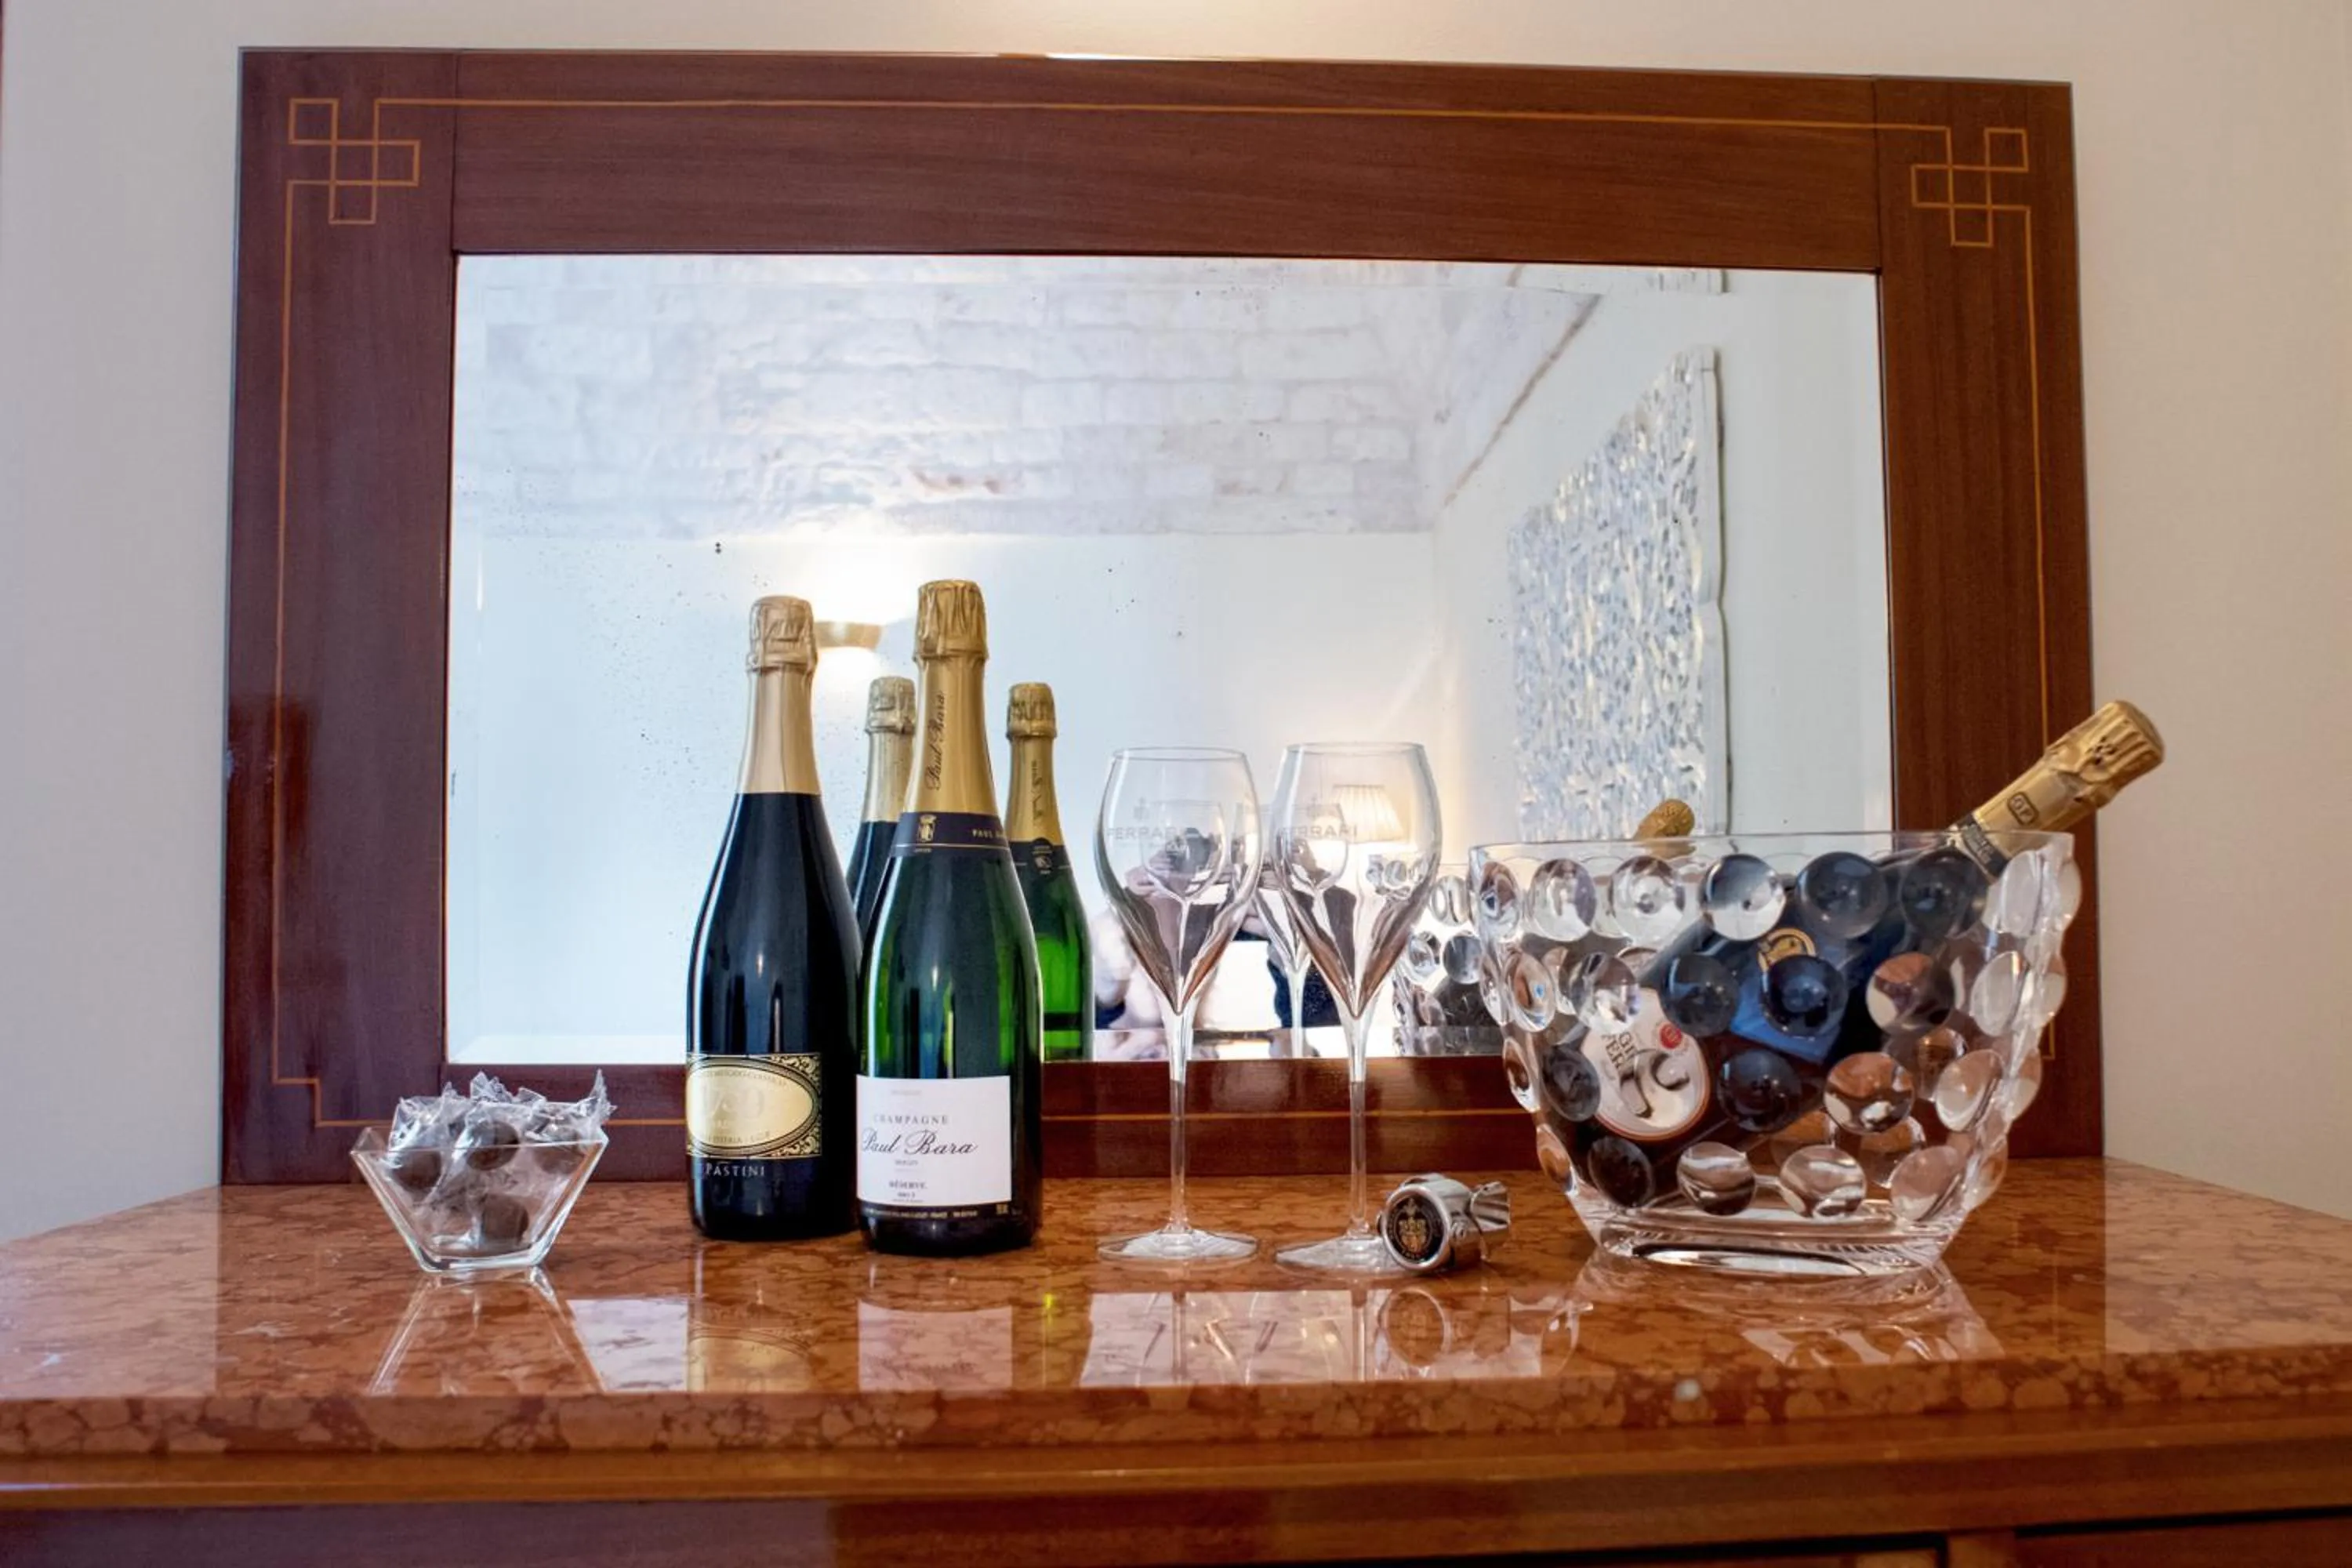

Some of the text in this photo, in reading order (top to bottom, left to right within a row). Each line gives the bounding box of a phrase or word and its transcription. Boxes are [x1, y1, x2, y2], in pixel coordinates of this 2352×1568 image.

[873, 1113, 949, 1125] CHAMPAGNE
[861, 1127, 978, 1156] Paul Bara
